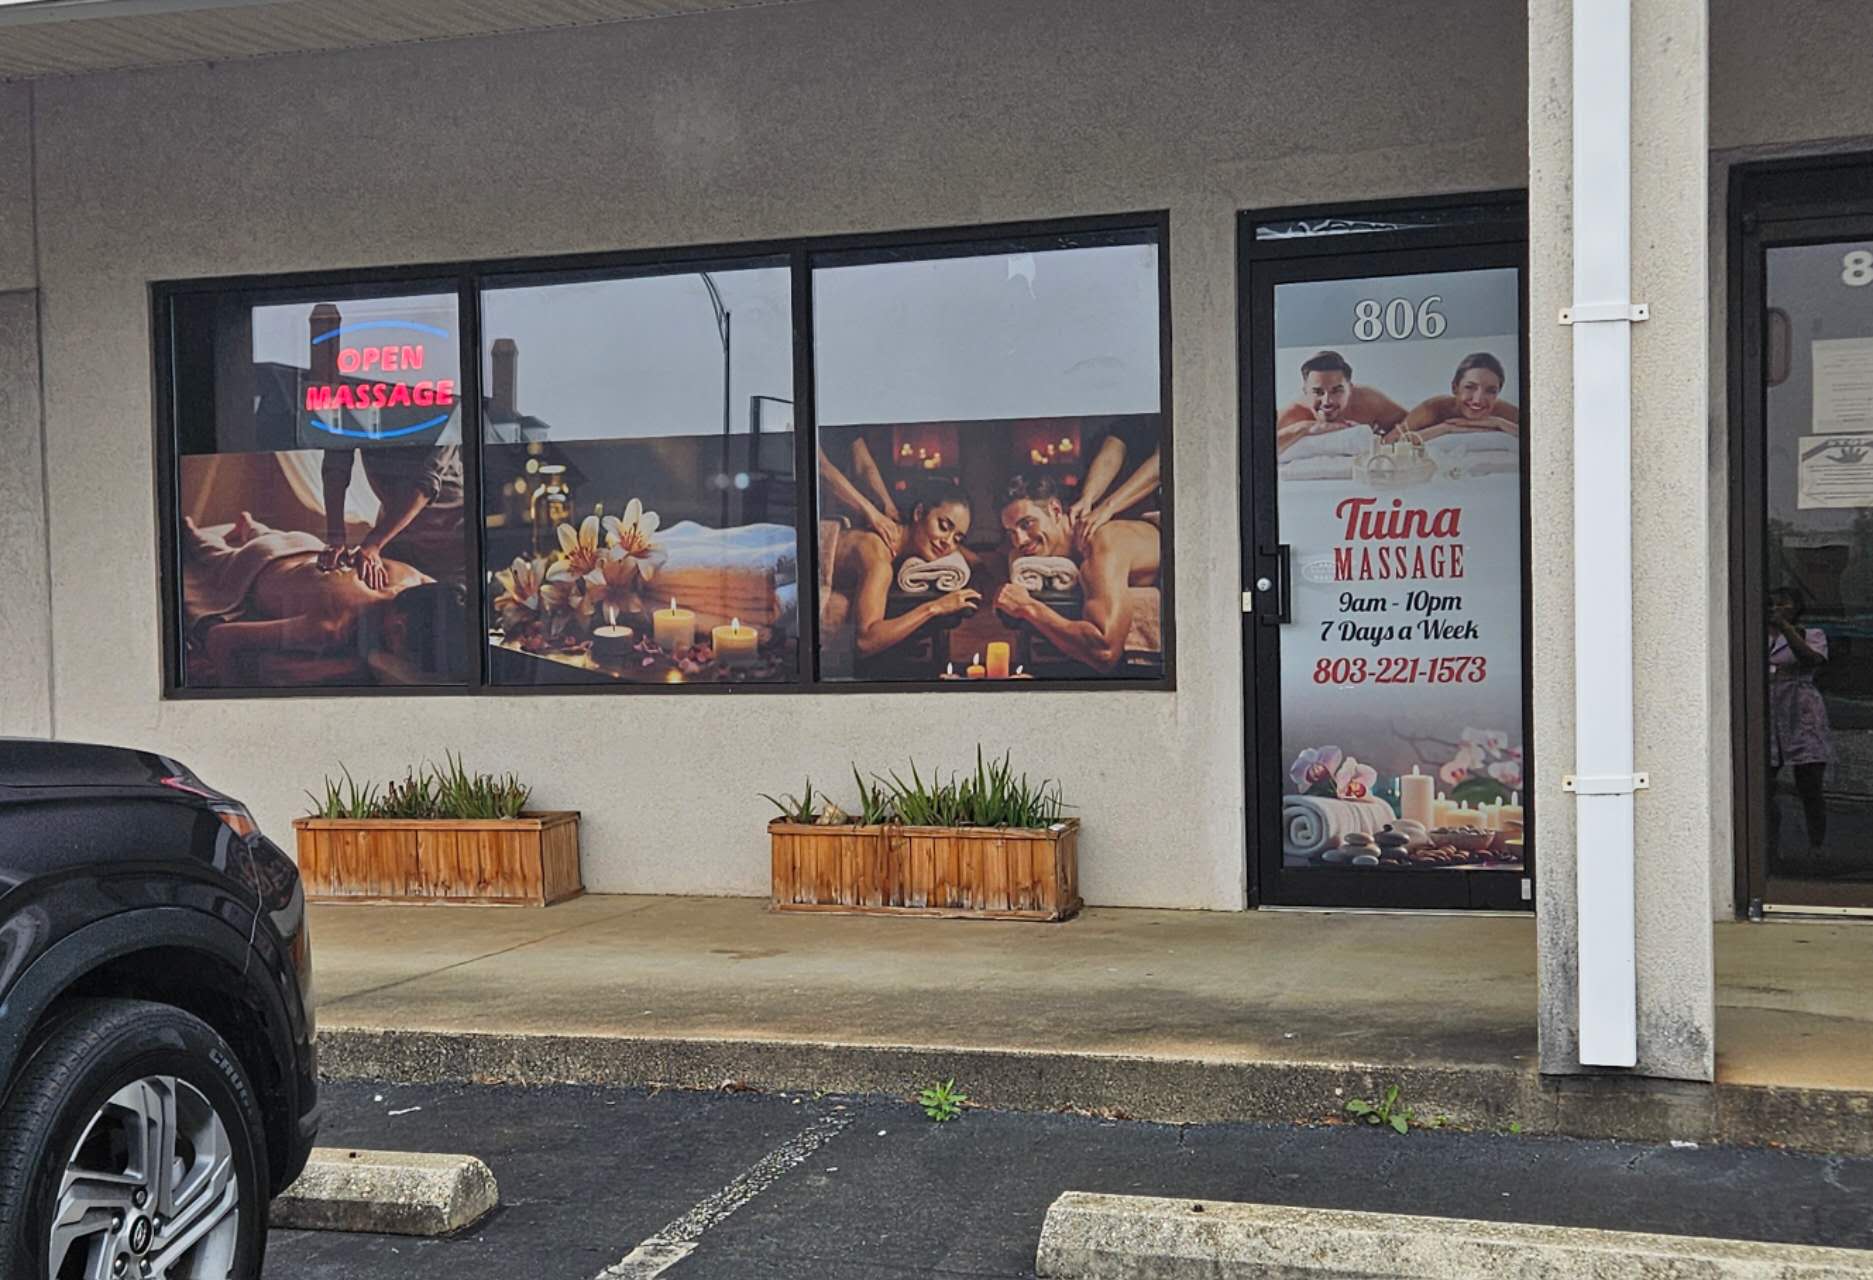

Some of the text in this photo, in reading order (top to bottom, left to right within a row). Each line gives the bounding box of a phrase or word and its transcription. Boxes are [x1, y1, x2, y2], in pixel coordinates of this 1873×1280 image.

[1353, 295, 1447, 341] 806
[337, 344, 424, 374] OPEN
[305, 379, 456, 411] MASSAGE
[1335, 497, 1462, 541] Tuina
[1334, 544, 1464, 581] MASSAGE
[1339, 592, 1387, 613] 9am
[1405, 590, 1462, 616] 10pm
[1320, 619, 1480, 647] 7 Days a Week
[1313, 656, 1487, 684] 803-221-1573
